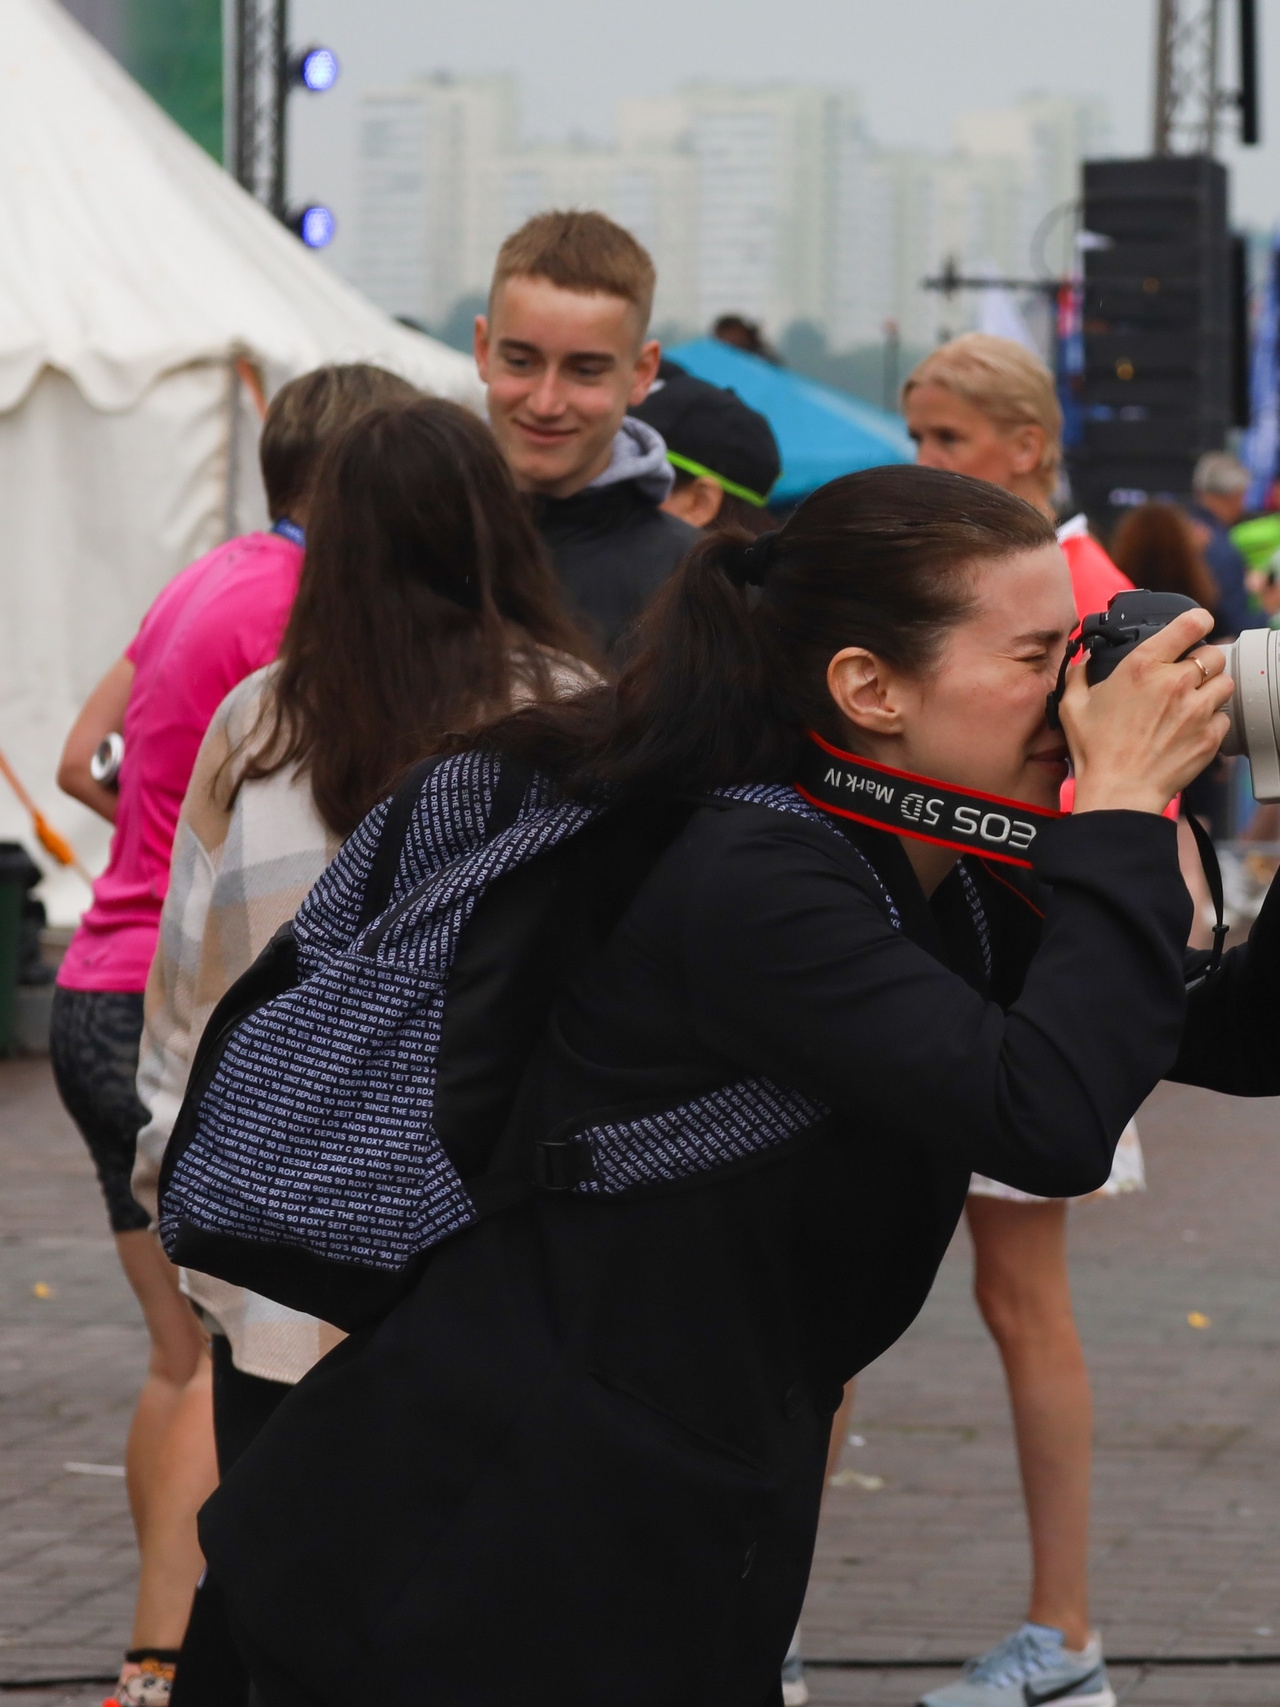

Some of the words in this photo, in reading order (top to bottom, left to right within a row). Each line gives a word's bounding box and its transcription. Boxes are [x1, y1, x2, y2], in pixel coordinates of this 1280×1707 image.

[451, 766, 459, 788] SINCE
[824, 768, 842, 786] IV
[846, 774, 895, 804] Mark
[441, 791, 450, 819] 90ERN
[462, 789, 470, 807] SEIT
[474, 802, 482, 814] 90
[900, 792, 945, 825] 5D
[412, 809, 418, 820] 90
[465, 810, 473, 828] DEN
[413, 822, 422, 846] ROXY
[424, 828, 435, 852] ROXY
[433, 815, 444, 844] 90ERN
[445, 821, 456, 845] ROXY
[528, 828, 538, 837] 90
[530, 826, 552, 854] DEPUIS
[952, 806, 1037, 850] EOS
[418, 849, 428, 866] SEIT
[514, 838, 530, 861] ROXY
[453, 910, 462, 933] ROXY
[419, 938, 429, 966] 90ERN
[441, 926, 449, 954] DESDE
[342, 973, 356, 983] THE
[378, 983, 400, 993] ROXY
[343, 961, 361, 973] ROXY
[394, 974, 416, 985] ROXY
[325, 992, 340, 1001] SEIT
[342, 996, 358, 1006] DEN
[361, 1002, 384, 1013] 90ERN
[328, 980, 347, 992] ROXY
[349, 987, 373, 998] SINCE
[375, 993, 389, 1002] THE
[292, 1005, 304, 1014] LOS
[306, 1009, 325, 1021] AÑOS
[328, 1016, 338, 1024] 90
[339, 1018, 358, 1030] ROXY
[359, 1025, 375, 1034] SEIT
[308, 997, 317, 1006] 90
[318, 1002, 338, 1013] ROXY
[340, 1006, 368, 1020] DEPUIS
[368, 1014, 377, 1023] 90
[295, 1018, 314, 1030] SINCE
[316, 1025, 331, 1034] THE
[348, 1033, 368, 1044] ROXY
[273, 1046, 292, 1057] ROXY
[294, 1052, 314, 1064] DESDE
[315, 1059, 327, 1068] LOS
[328, 1063, 349, 1074] AÑOS
[286, 1039, 306, 1050] ROXY
[307, 1044, 330, 1057] DEPUIS
[331, 1051, 339, 1060] 90
[341, 1055, 364, 1066] ROXY
[248, 1050, 259, 1059] LOS
[260, 1054, 278, 1065] AÑOS
[279, 1061, 289, 1069] 90
[291, 1064, 306, 1074] ROXY
[306, 1069, 319, 1078] SEIT
[321, 1074, 336, 1083] DEN
[339, 1078, 367, 1086] 90ERN
[369, 1081, 394, 1090] ROXY
[253, 1064, 262, 1072] 90
[262, 1068, 282, 1079] ROXY
[283, 1074, 300, 1084] SINCE
[301, 1078, 312, 1088] THE
[333, 1088, 357, 1097] ROXY
[392, 1096, 415, 1105] ROXY
[245, 1086, 267, 1098] DESDE
[296, 1101, 305, 1110] 90
[306, 1104, 331, 1115] ROXY
[334, 1110, 353, 1118] SEIT
[355, 1112, 373, 1121] DEN
[375, 1116, 402, 1126] 90ERN
[403, 1120, 427, 1129] ROXY
[296, 1090, 321, 1102] DEPUIS
[323, 1097, 334, 1105] 90
[337, 1100, 362, 1108] ROXY
[364, 1103, 389, 1113] SINCE
[392, 1107, 407, 1115] THE
[292, 1113, 319, 1125] DESDE
[322, 1119, 340, 1127] LOS
[342, 1121, 366, 1132] AÑOS
[368, 1126, 379, 1134] 90
[380, 1129, 404, 1138] ROXY
[405, 1132, 423, 1141] SEIT
[705, 1101, 725, 1120] ROXY
[730, 1126, 740, 1137] 90
[731, 1095, 742, 1106] 90
[740, 1105, 761, 1124] ROXY
[759, 1124, 777, 1140] SEIT
[731, 1111, 752, 1132] ROXY
[288, 1124, 312, 1134] ROXY
[314, 1129, 346, 1140] DEPUIS
[360, 1137, 383, 1146] ROXY
[385, 1140, 409, 1150] SINCE
[641, 1117, 664, 1140] 90ERN
[662, 1139, 683, 1158] ROXY
[681, 1126, 703, 1147] SINCE
[701, 1145, 716, 1161] THE
[685, 1114, 706, 1133] ROXY
[704, 1132, 721, 1149] SEIT
[294, 1147, 319, 1158] ROXY
[321, 1153, 347, 1163] DESDE
[348, 1157, 364, 1165] LOS
[366, 1159, 391, 1170] AÑOS
[394, 1165, 405, 1173] 90
[319, 1141, 344, 1151] ROXY
[353, 1146, 364, 1154] 90
[365, 1148, 389, 1158] ROXY
[391, 1153, 423, 1163] DEPUIS
[605, 1125, 628, 1152] DEPUIS
[626, 1150, 637, 1161] 90
[636, 1160, 658, 1179] ROXY
[607, 1146, 622, 1161] LOS
[620, 1161, 642, 1181] AÑOS
[303, 1172, 332, 1183] DEPUIS
[330, 1165, 353, 1175] AÑOS
[355, 1170, 366, 1178] 90
[368, 1171, 394, 1182] ROXY
[309, 1206, 334, 1217] SINCE
[337, 1211, 354, 1220] THE
[378, 1218, 404, 1227] ROXY
[348, 1201, 373, 1211] ROXY
[375, 1206, 404, 1217] DESDE
